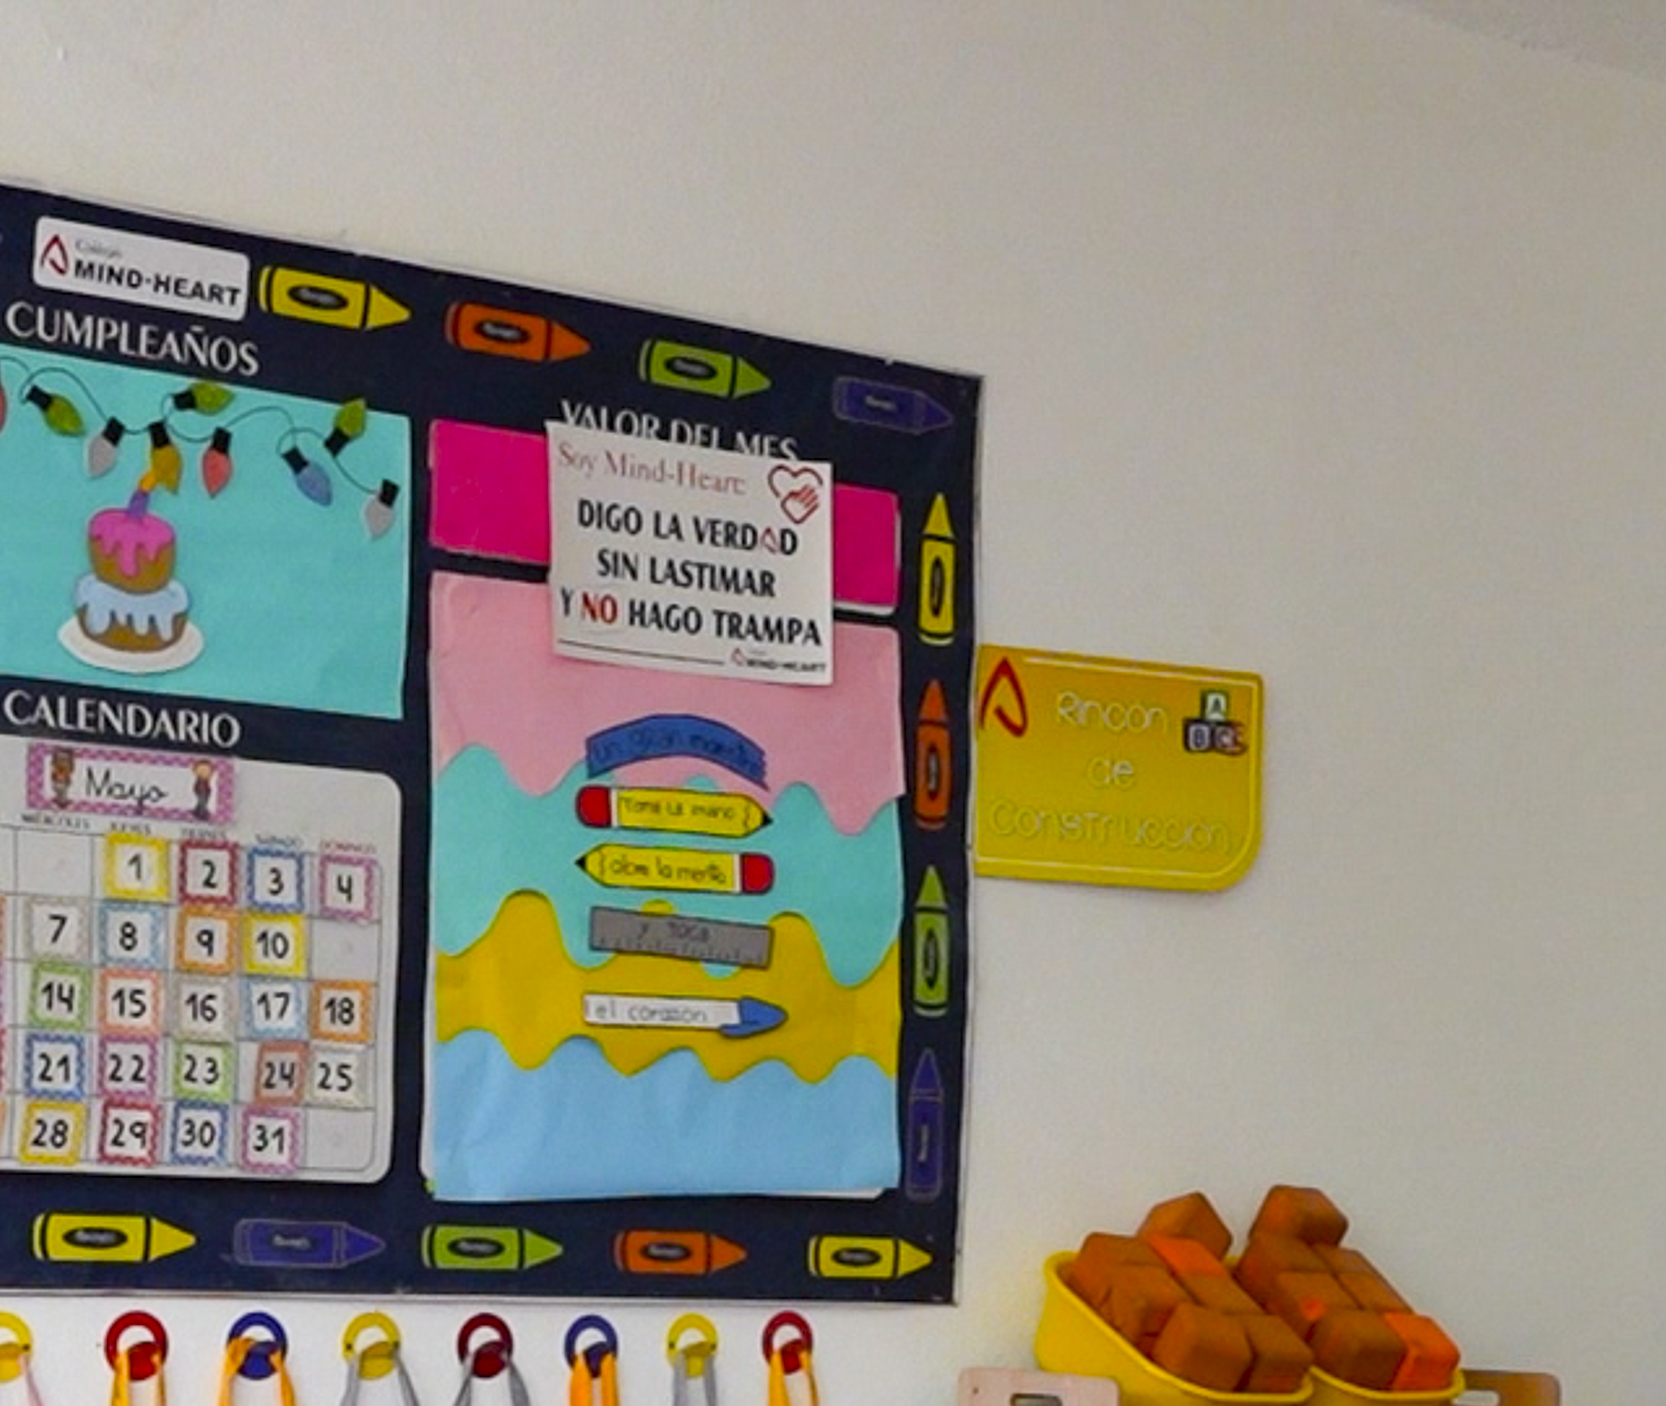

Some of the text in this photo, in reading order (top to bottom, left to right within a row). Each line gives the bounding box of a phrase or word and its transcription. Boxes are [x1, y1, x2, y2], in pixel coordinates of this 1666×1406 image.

[5, 300, 259, 377] CUMPLEAÑOS
[558, 441, 597, 479] Soy
[578, 499, 643, 534] DIGO
[653, 511, 684, 542] LA
[597, 549, 776, 598] SIN LASTIMAR
[560, 588, 822, 648] Y NO HAGO TRAMPA
[3, 689, 241, 748] CALENDARIO
[85, 766, 169, 815] Mayo
[127, 853, 353, 903] 1 2 3 4
[49, 914, 68, 944] 7
[119, 921, 138, 952] 8
[196, 929, 214, 957] 9
[256, 929, 290, 960] 10
[41, 981, 75, 1013] 14
[111, 988, 147, 1019] 15
[185, 992, 217, 1023] 16
[256, 991, 290, 1021] 17
[324, 996, 355, 1026] 18
[38, 1052, 71, 1083] 21
[108, 1053, 147, 1083] 22
[183, 1053, 220, 1085] 23
[262, 1061, 296, 1090] 24
[317, 1062, 353, 1093] 25
[31, 1118, 69, 1149] 28
[110, 1117, 149, 1148] 29
[180, 1118, 217, 1149] 30
[253, 1124, 285, 1154] 31
